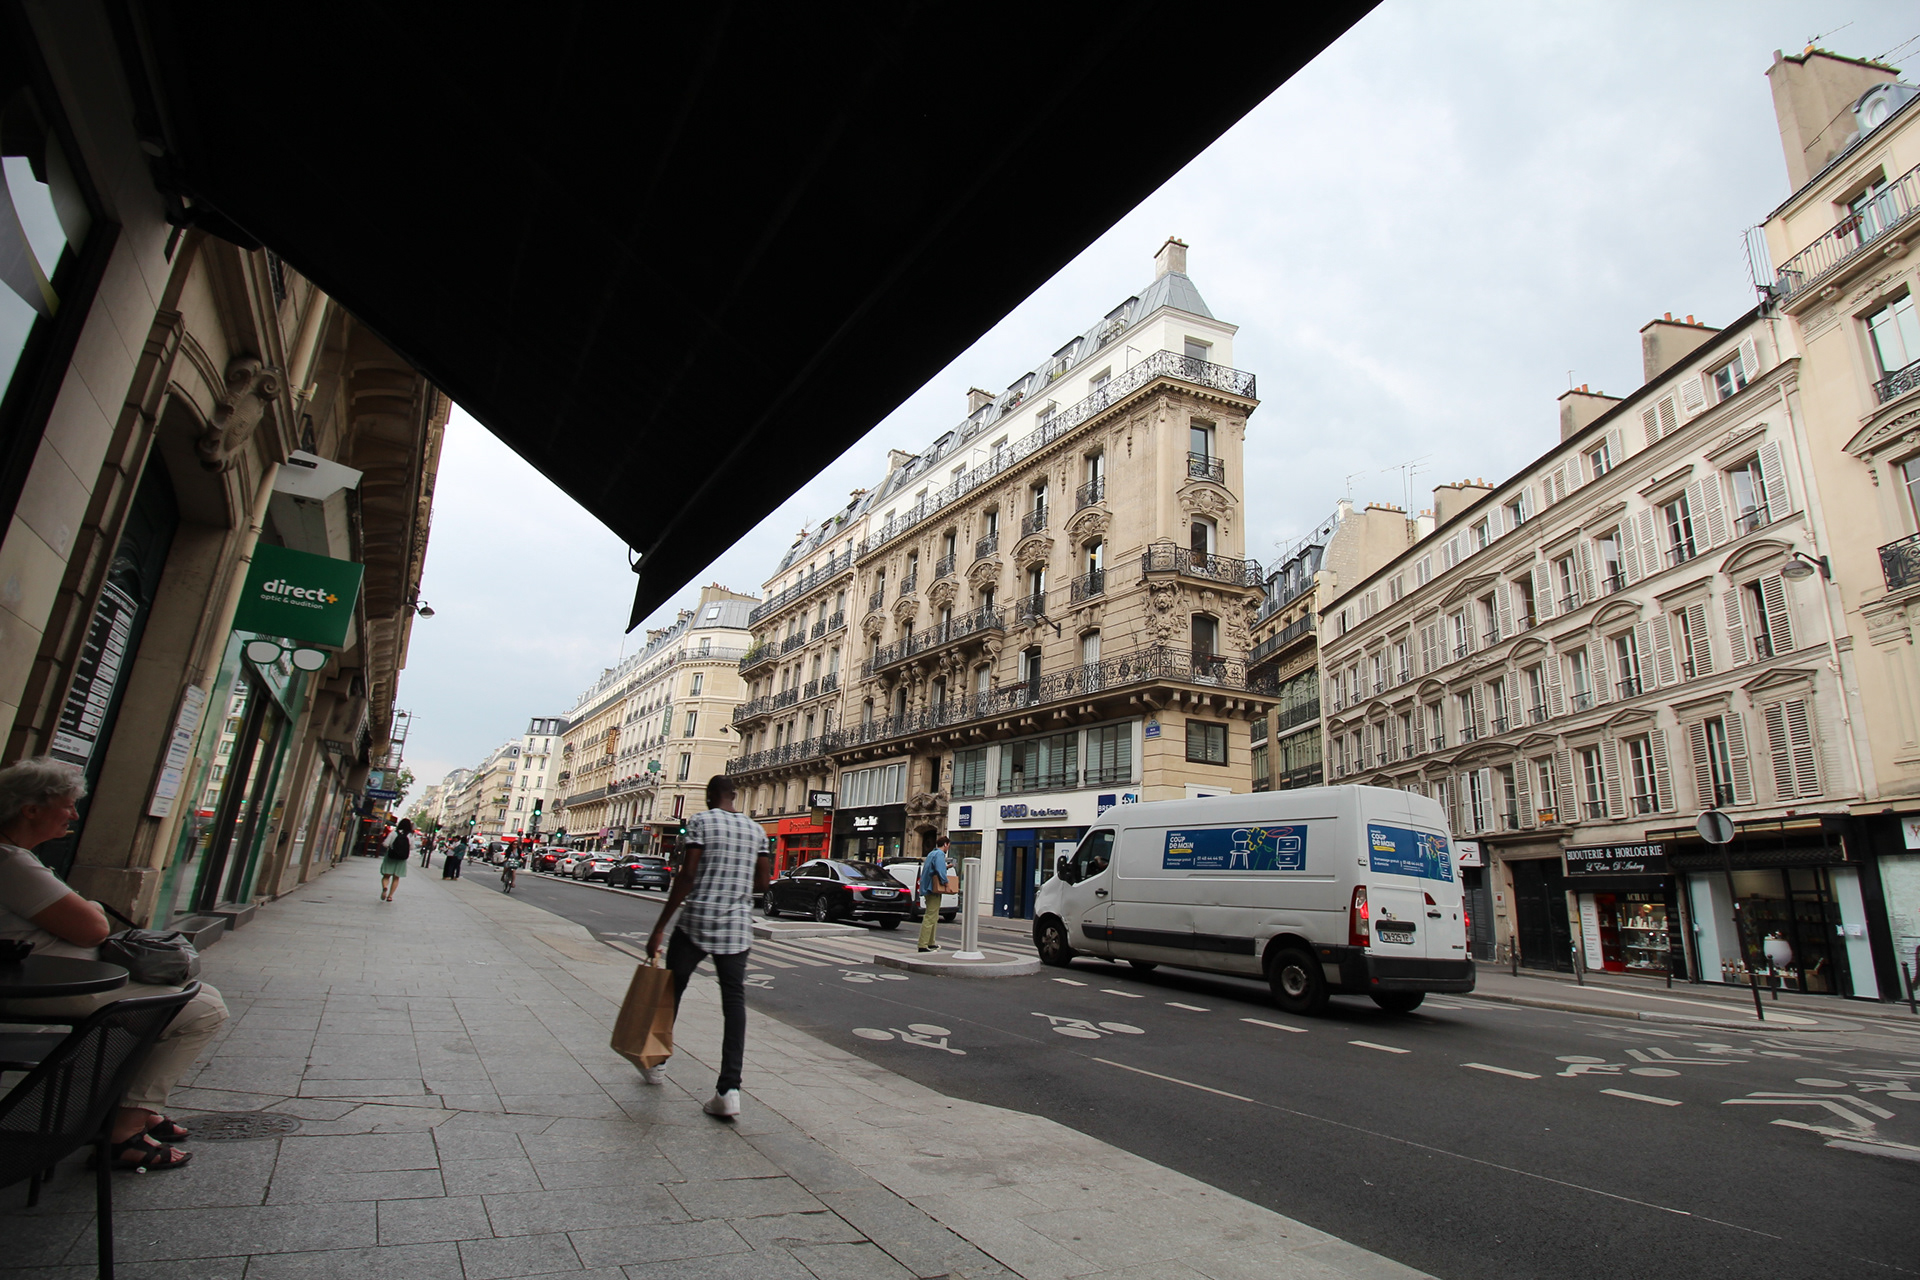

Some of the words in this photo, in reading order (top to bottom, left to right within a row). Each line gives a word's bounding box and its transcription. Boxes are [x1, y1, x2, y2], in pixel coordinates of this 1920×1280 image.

[260, 594, 282, 602] optic
[290, 600, 323, 610] audition
[1000, 804, 1028, 818] BRED
[1047, 808, 1068, 816] France
[1566, 849, 1604, 860] BIJOUTERIE
[1606, 848, 1612, 858] &
